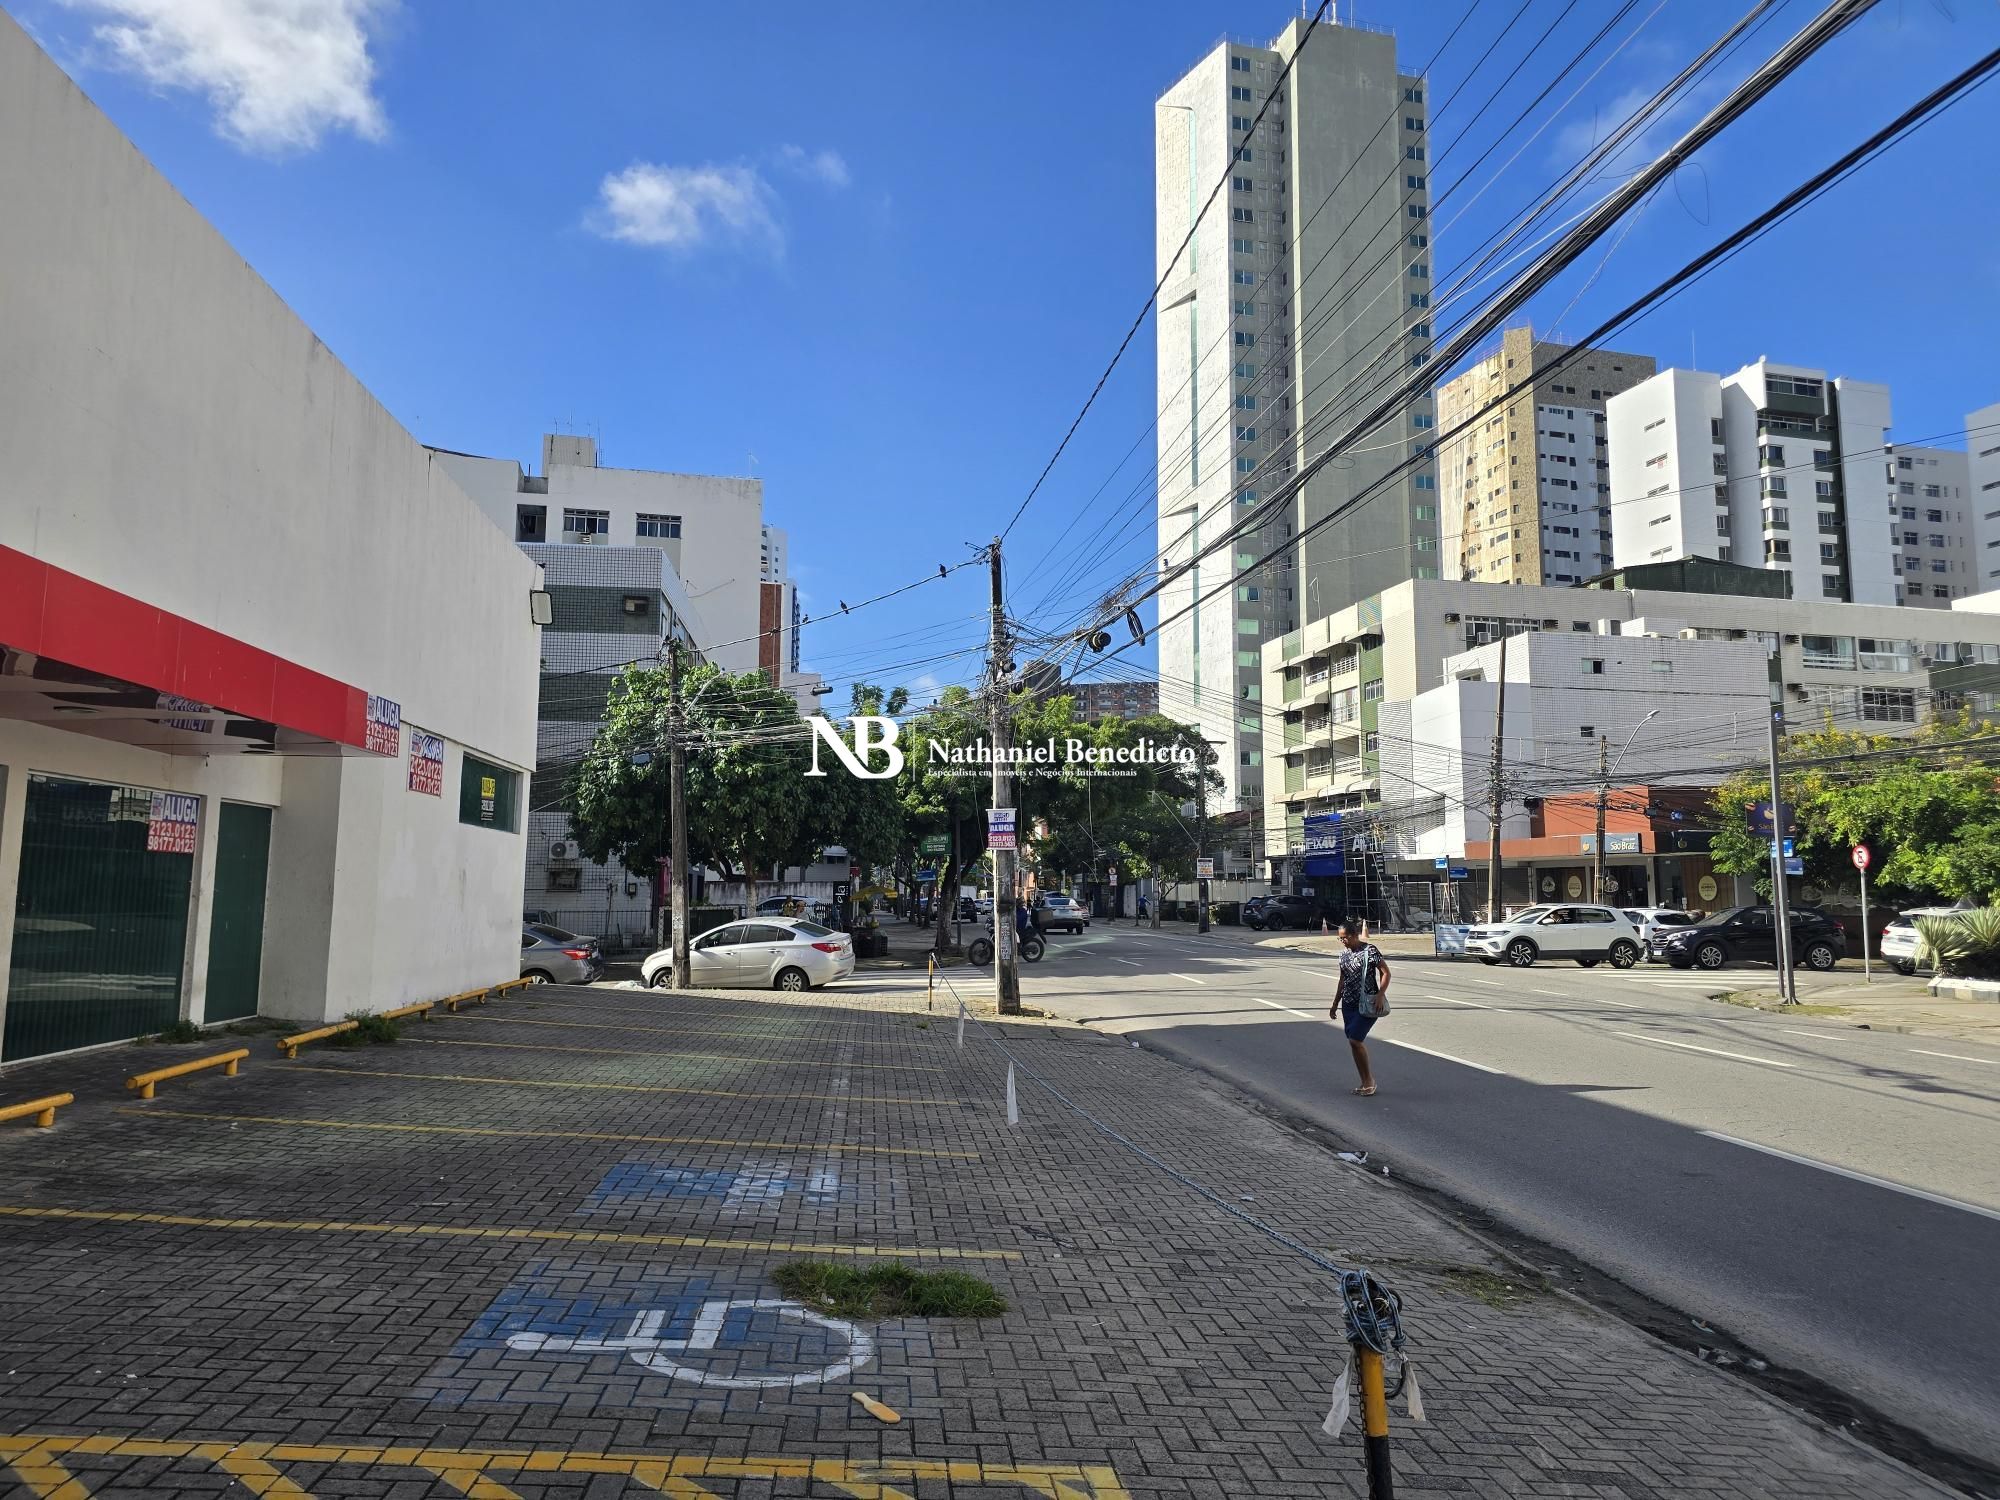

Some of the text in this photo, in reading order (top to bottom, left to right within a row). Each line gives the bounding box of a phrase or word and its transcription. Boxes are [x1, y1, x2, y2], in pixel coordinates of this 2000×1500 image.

[375, 698, 399, 728] ALUGA
[366, 720, 399, 743] 2123.0123
[365, 734, 398, 757] 98177.0123
[422, 736, 443, 761] ALUGA
[410, 755, 442, 779] 2123.0123
[164, 795, 197, 823] ALUGA
[149, 821, 196, 839] 2123.0123
[989, 824, 1015, 832] ALUGA
[147, 836, 195, 853] 98177.0123
[1621, 841, 1635, 850] Braz
